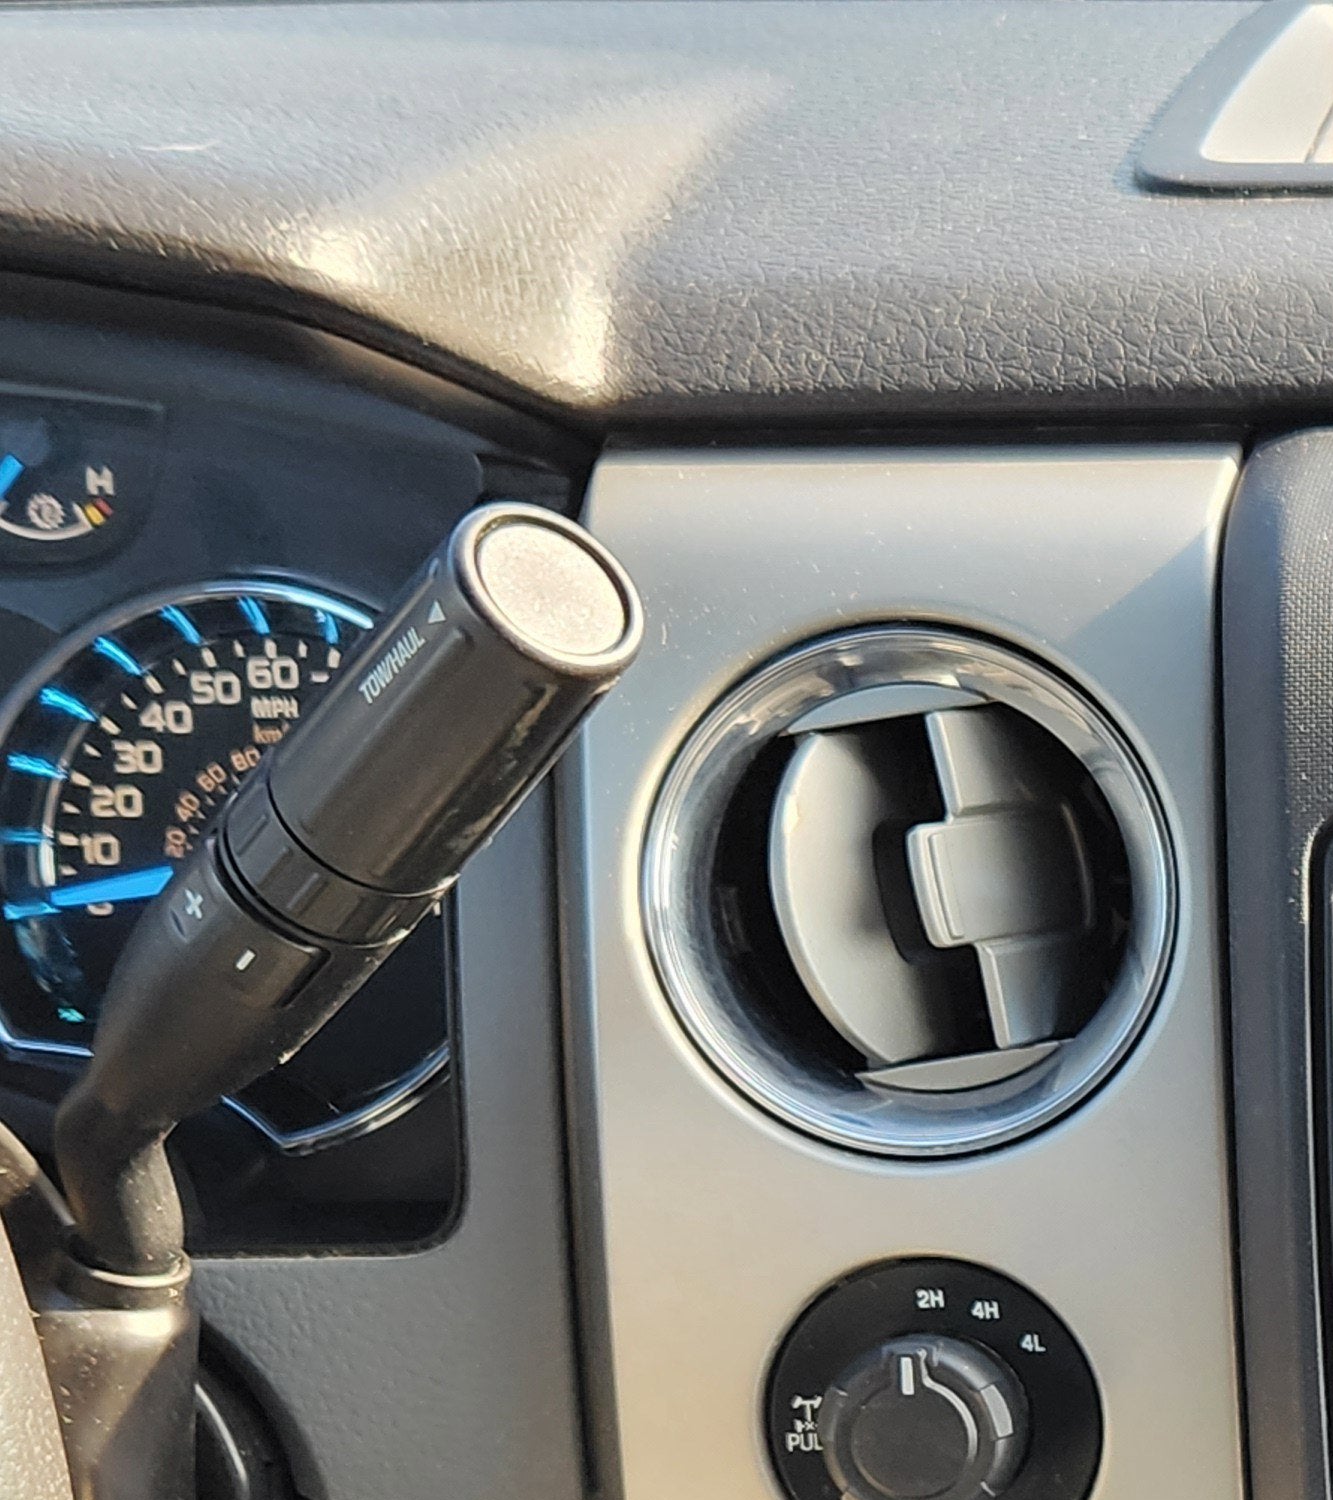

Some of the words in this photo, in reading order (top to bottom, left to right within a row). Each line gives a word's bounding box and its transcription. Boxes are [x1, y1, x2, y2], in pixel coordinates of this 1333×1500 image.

[86, 465, 115, 496] H
[247, 656, 299, 690] 60
[358, 626, 426, 704] TOW/HAUL
[190, 671, 241, 705] 50
[139, 701, 194, 734] 40
[251, 696, 299, 719] MPH
[111, 740, 163, 774] 30
[230, 745, 261, 772] 80
[196, 762, 227, 793] 60
[90, 785, 143, 818] 20
[175, 790, 200, 822] 40
[81, 832, 121, 866] 10
[916, 1289, 945, 1308] 2H
[971, 1301, 1000, 1320] 4H
[1019, 1334, 1046, 1352] 4L
[785, 1432, 823, 1452] PUL
